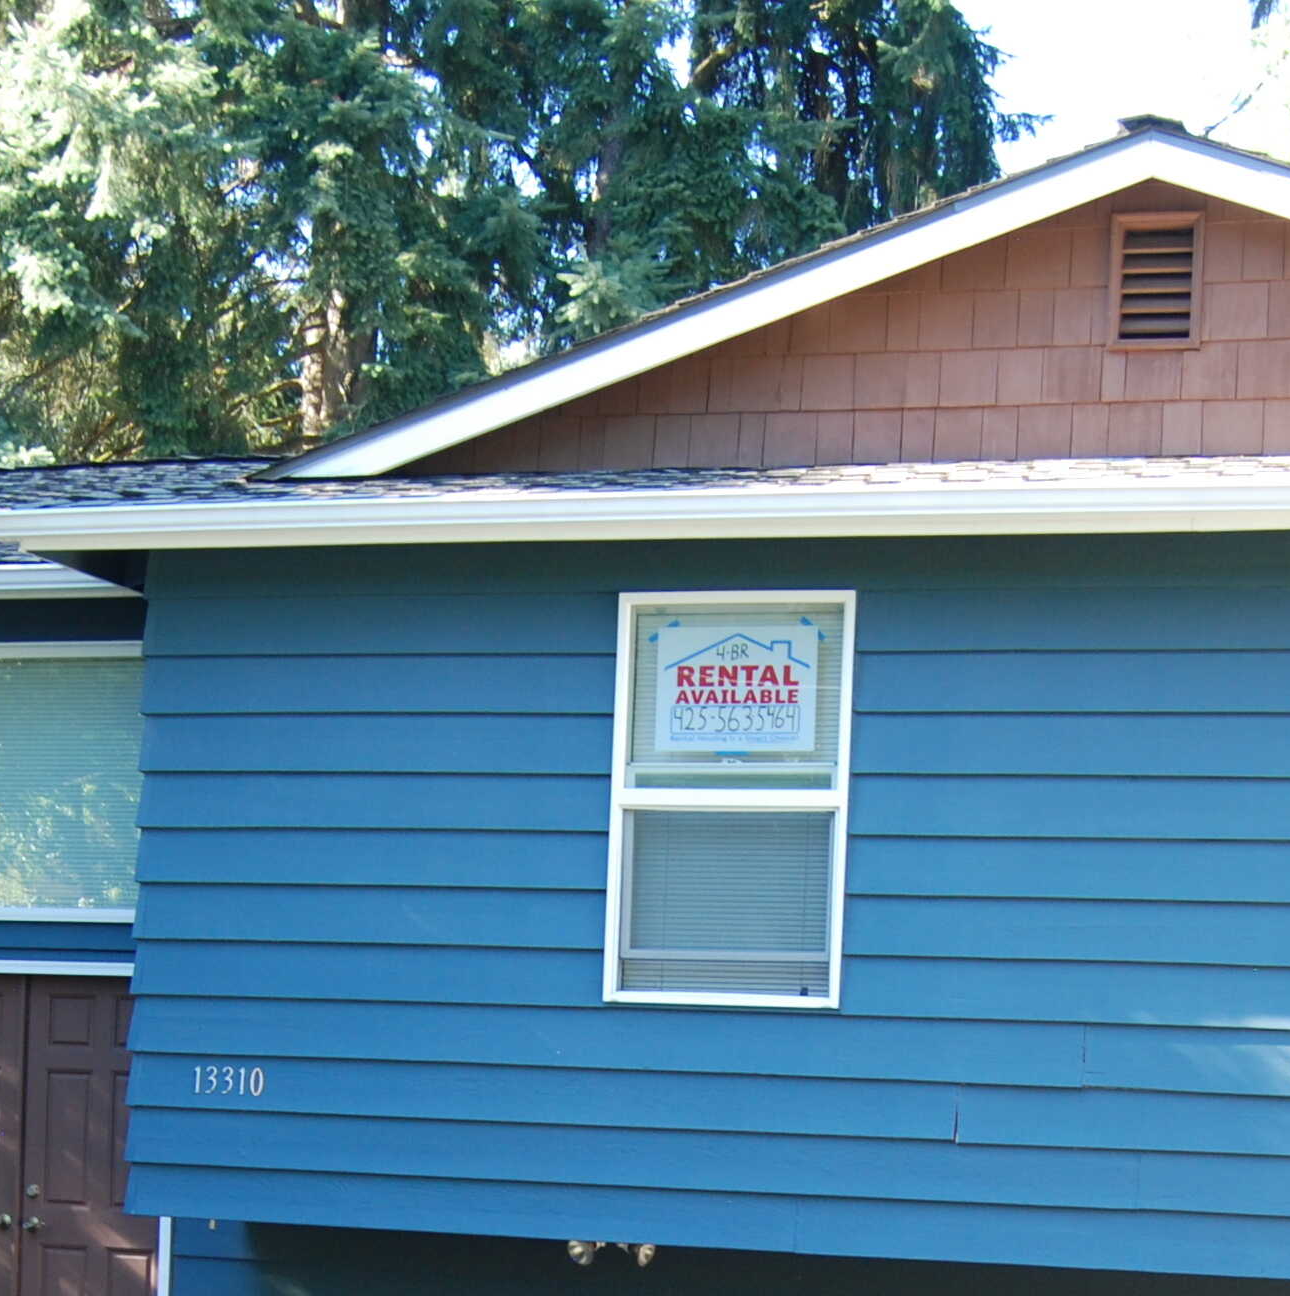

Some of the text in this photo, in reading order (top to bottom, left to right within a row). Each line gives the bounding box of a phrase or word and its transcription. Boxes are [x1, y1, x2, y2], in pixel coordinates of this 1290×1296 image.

[676, 665, 800, 687] RENTAL
[675, 689, 799, 704] AVAILABLE
[194, 1065, 264, 1096] 13310
